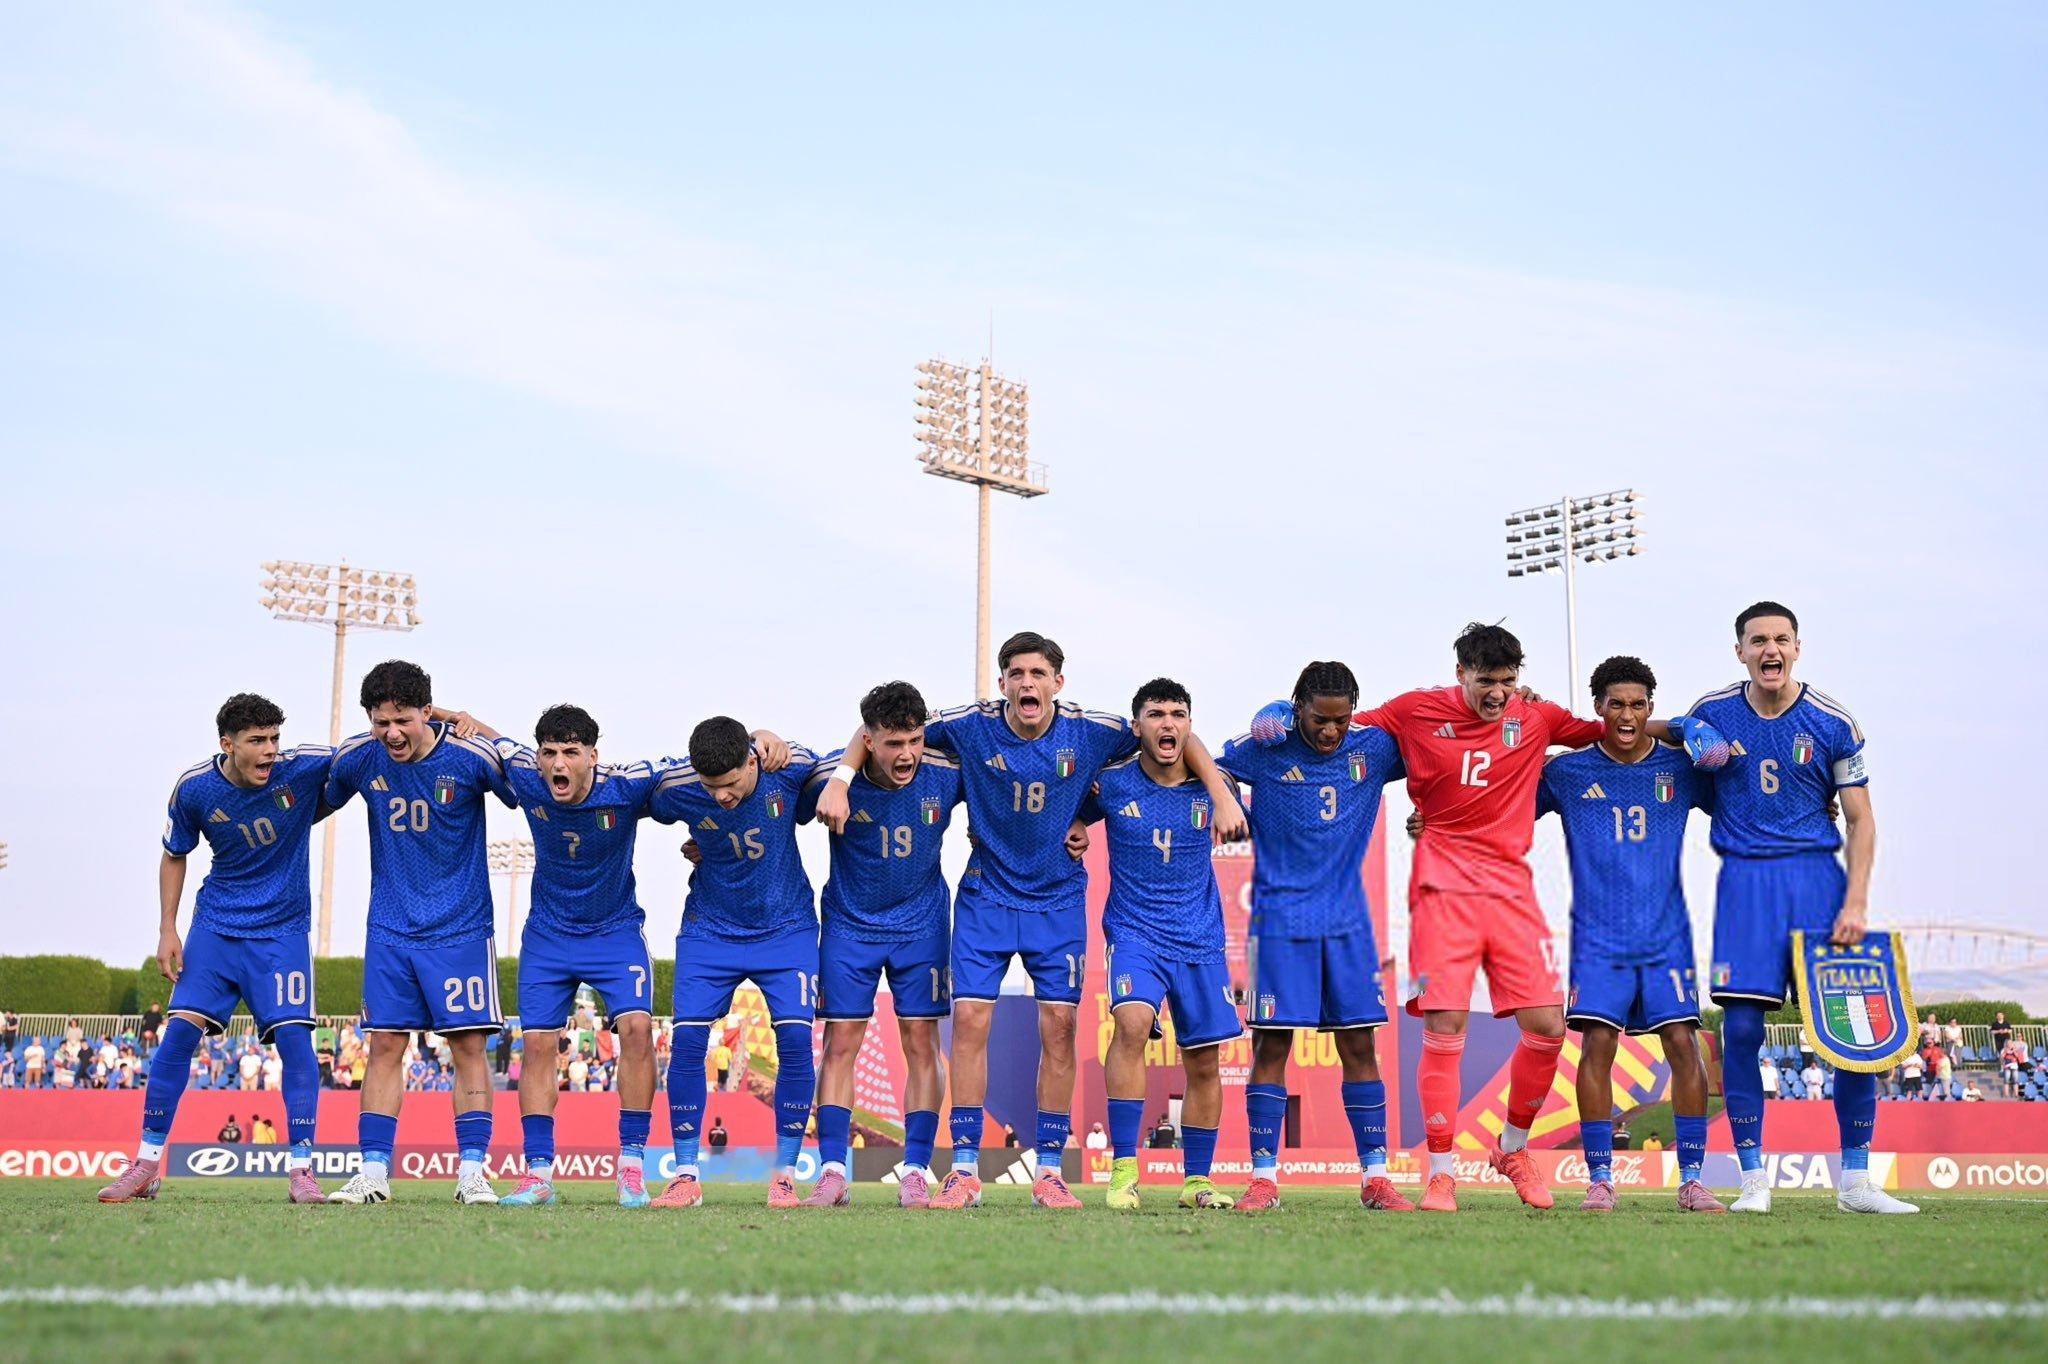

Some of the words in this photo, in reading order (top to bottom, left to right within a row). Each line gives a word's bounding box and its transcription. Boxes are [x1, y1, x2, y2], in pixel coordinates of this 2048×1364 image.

[1460, 749, 1492, 787] 12
[1759, 758, 1780, 795] 6
[1013, 781, 1046, 813] 18
[1319, 786, 1337, 820] 3
[389, 797, 429, 832] 20
[1612, 805, 1646, 843] 13
[238, 817, 277, 849] 10
[562, 831, 581, 859] 7
[728, 827, 765, 860] 15
[880, 825, 912, 859] 19
[1152, 828, 1172, 864] 4
[274, 970, 306, 1007] 10
[444, 976, 485, 1013] 20
[629, 965, 646, 998] 7
[1250, 1126, 1273, 1134] TALIA
[0, 1149, 130, 1177] enovo
[402, 1152, 495, 1178] QATR
[499, 1153, 614, 1177] AIWAYS
[1147, 1162, 1177, 1173] FIFA
[1283, 1162, 1326, 1175] QATAR
[1328, 1162, 1360, 1174] 2025
[1967, 1161, 2048, 1185] moto
